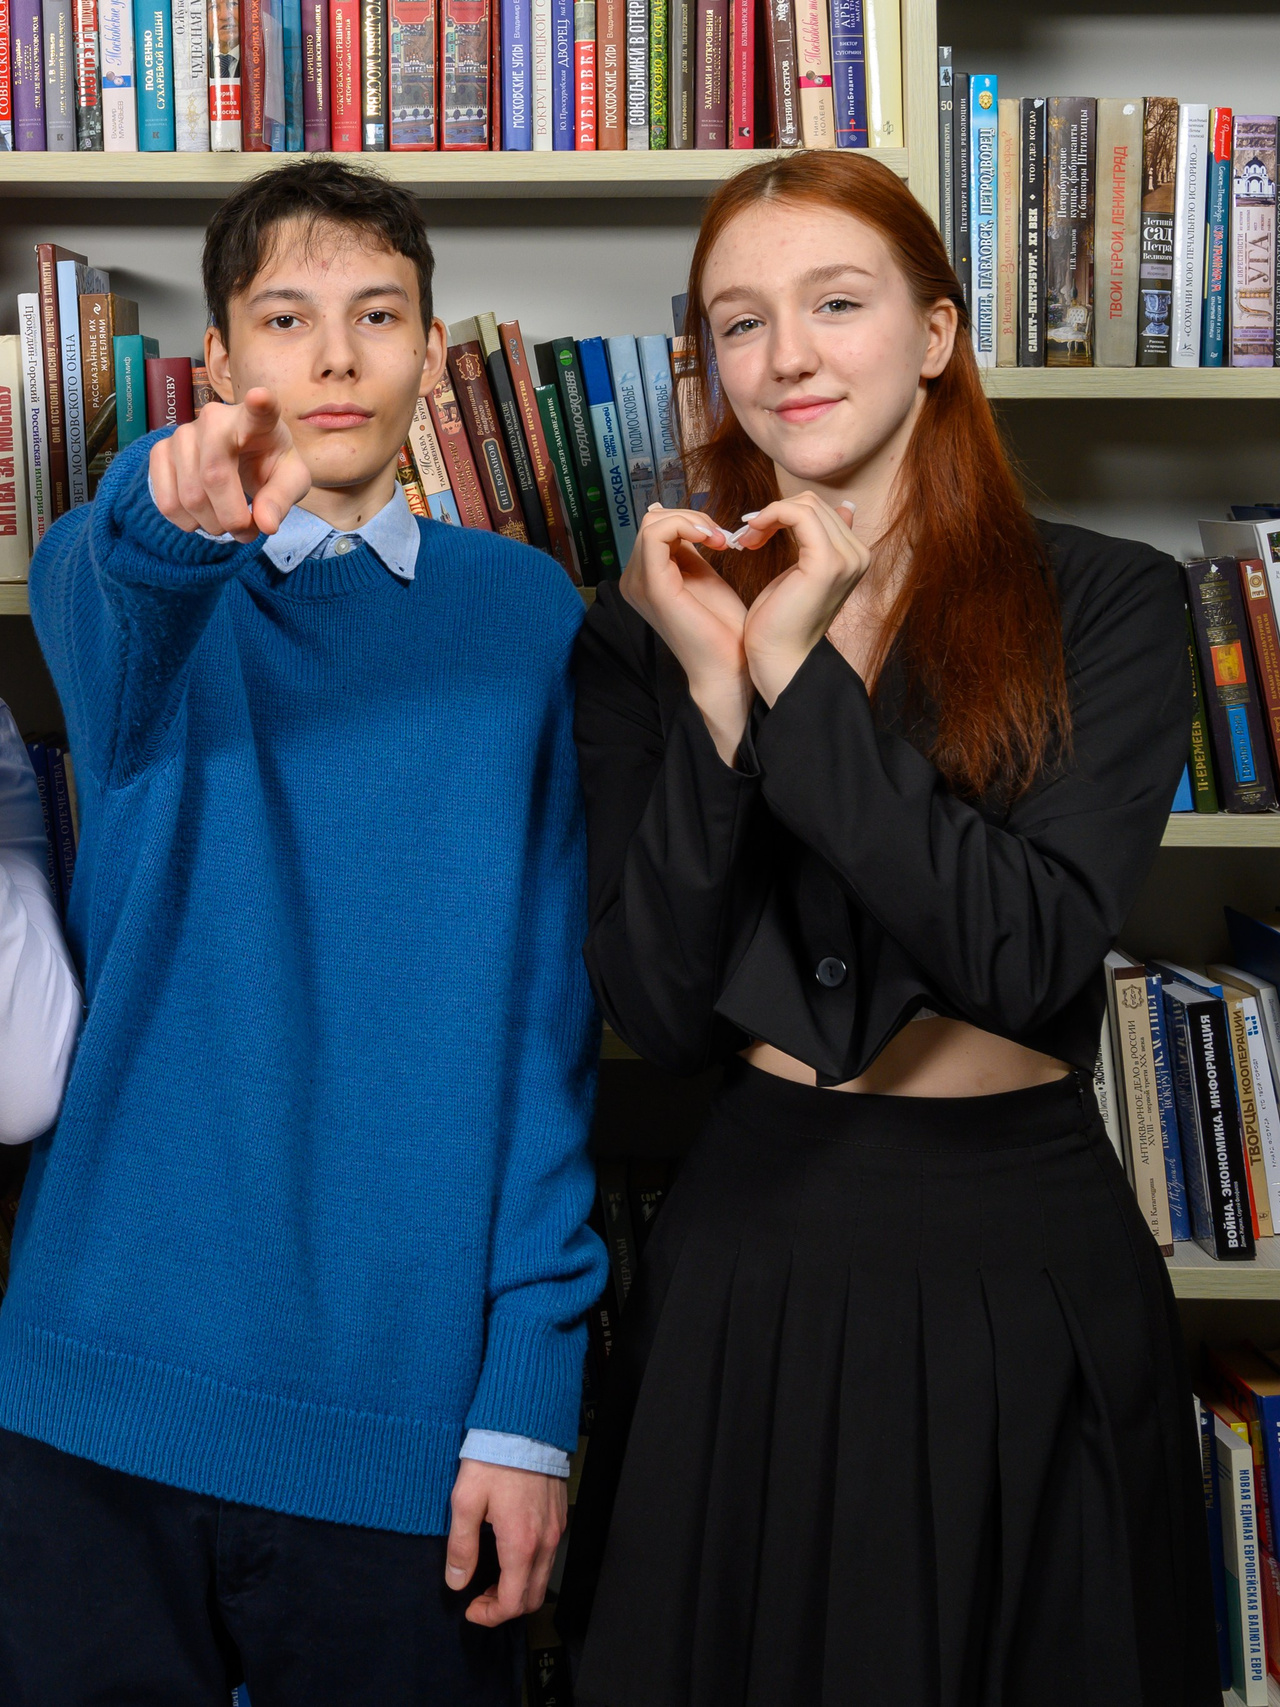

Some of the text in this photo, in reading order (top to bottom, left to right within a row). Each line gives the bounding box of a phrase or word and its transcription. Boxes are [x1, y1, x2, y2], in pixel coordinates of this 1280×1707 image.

[103, 9, 123, 66] Московские
[154, 11, 164, 49] БАШНИ
[560, 7, 567, 16] на
[704, 9, 714, 64] ОТКРОВЕНИЯ
[144, 30, 154, 91] ПОД СЕНЬЮ
[191, 12, 205, 79] ЧУДЕСНАЯ
[307, 35, 315, 82] ЦАРИЦЫНО
[335, 9, 344, 115] ПОКРОВСКОЕ-СТРЕШНЕВО
[557, 19, 571, 68] ДВОРЕЦ
[604, 44, 617, 68] УГЛЫ
[801, 13, 822, 65] Московские
[155, 51, 166, 110] СУХАРЕВОЙ
[511, 4, 525, 129] МОСКОВСКИЕ УГЛЫ Владимир
[534, 13, 547, 136] ВОКРУГ НЕМЕЦКОЙ
[704, 74, 712, 110] ЗАГАДКИ
[781, 60, 792, 96] ОСЕТРОВ
[581, 44, 594, 143] РУБЛЕВКА
[604, 70, 618, 129] МОСКОВСКИЕ
[940, 100, 952, 111] 50
[117, 101, 126, 139] МУРАВЬЕВ
[560, 121, 567, 131] Ю.
[959, 98, 967, 147] РЕВОЛЮЦИИ
[1029, 110, 1037, 141] КОГДА?
[1078, 109, 1089, 166] Штиглицы
[1029, 143, 1037, 161] ГДЕ?
[1029, 163, 1037, 184] ЧТО?
[1068, 124, 1080, 219] купцы, фабриканты
[1057, 148, 1069, 219] Петербургские
[1079, 169, 1089, 210] банкиры
[959, 190, 969, 233] ПЕТЕРБУРГ
[1028, 208, 1038, 230] ВЕК
[1109, 145, 1128, 320] ТВОИ ГЕРОИ, ЛЕНИНГРАД
[1143, 226, 1173, 245] сад
[977, 128, 995, 353] ПУШКИН, ПАВЛОВСК, ПЕТРОДВОРЕЦ
[1142, 241, 1173, 253] Петра
[1142, 253, 1173, 261] Великого
[1028, 249, 1038, 353] САНКТ-ПЕТЕРБУРГ.
[24, 305, 39, 403] Прокудин-Горский
[88, 319, 100, 408] РАССКАЗАННЫЕ ИХ
[99, 319, 108, 371] ЖИТЕЛЯМИ
[123, 356, 134, 422] Московский миф
[466, 385, 485, 436] Воспоминания
[479, 405, 490, 435] старого
[483, 399, 497, 433] москвича
[564, 370, 592, 467] ПОДМОСКОВЬЕ
[603, 407, 618, 457] пяти морей
[622, 384, 644, 453] ПОДМОСКОВЬЕ
[426, 433, 446, 487] ТАИНСТВЕННАЯ
[487, 445, 504, 486] РОЗАНОВ
[501, 401, 529, 491] ПРОГУЛКИ ПО МОСКВЕ
[518, 379, 556, 526] Москва. Дорогами искусства
[546, 398, 579, 518] ЗАГОРСКИЙ МУЗЕЙ-ЗАПОВЕДНИК
[602, 434, 631, 528] МОСКВА порт
[1127, 1021, 1138, 1061] РОССИИ
[1131, 1068, 1143, 1092] ДЕЛО
[1143, 1071, 1151, 1089] трети
[1144, 1091, 1152, 1115] первой
[1232, 1011, 1262, 1168] ТВОРЦЫ КООПЕРАЦИИ
[1135, 1095, 1150, 1166] АНТИКВАРНОЕ
[1200, 1015, 1239, 1250] ВОЙНА. ЭКОНОМИКА. ИНФОРМАЦИЯ
[1239, 1468, 1262, 1680] НОВАЯ ЕДИНАЯ ЕВРОПЕЙСКАЯ ВАЛЮТА ЕВРО
